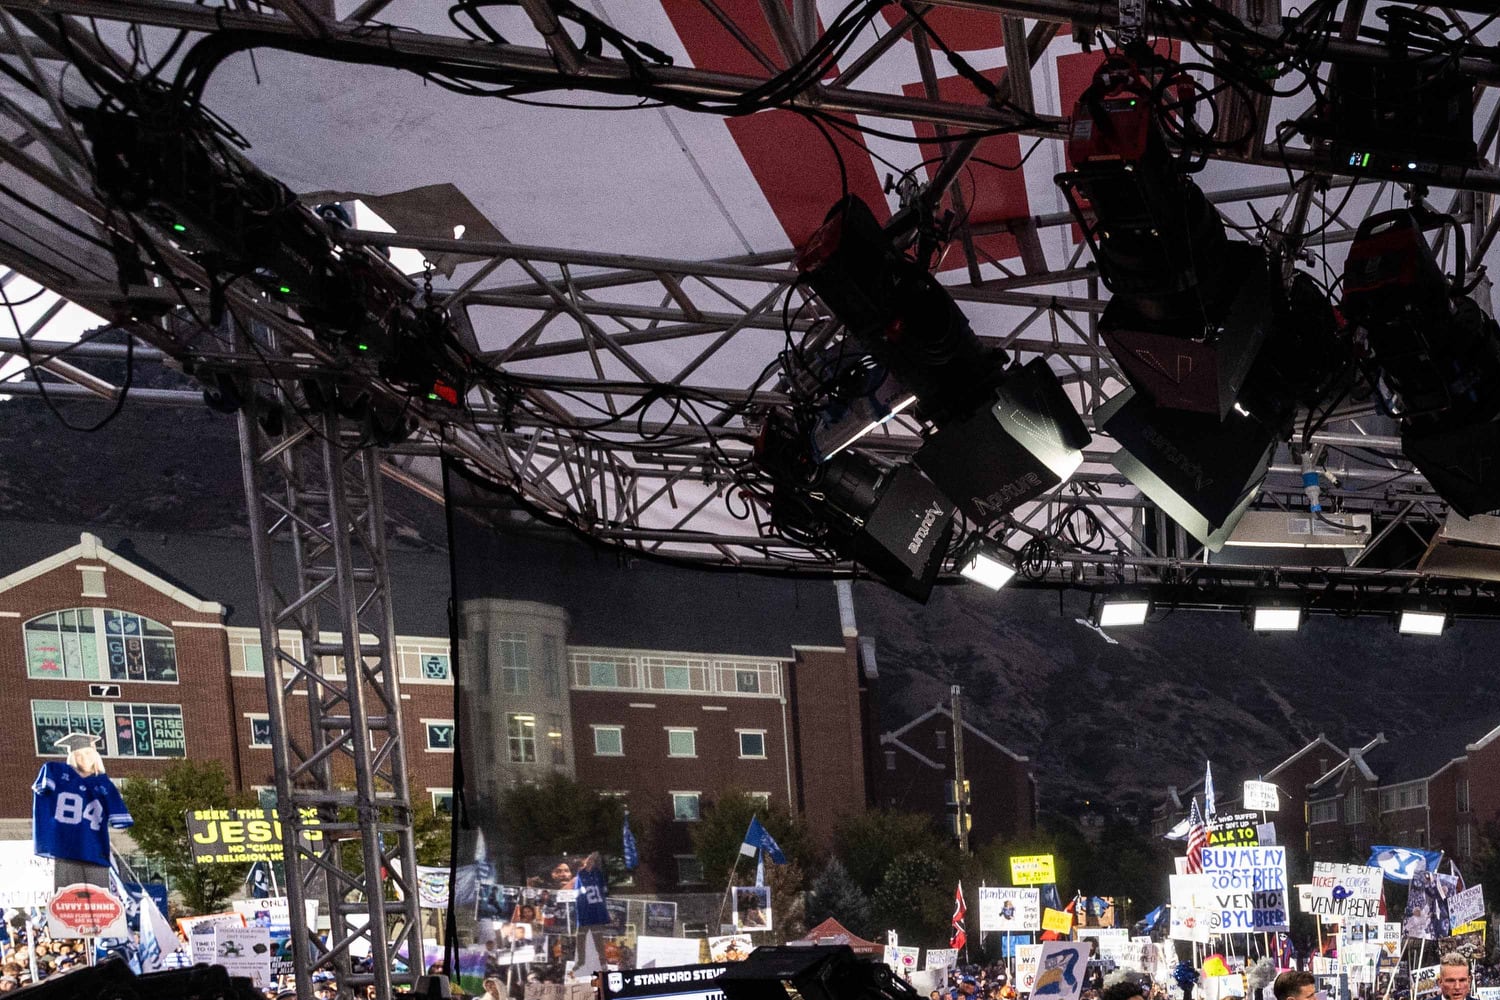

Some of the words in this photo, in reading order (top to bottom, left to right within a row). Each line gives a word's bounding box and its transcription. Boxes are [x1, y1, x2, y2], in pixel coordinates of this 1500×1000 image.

[970, 471, 1043, 517] Aputure
[907, 500, 945, 555] Aputure
[99, 685, 110, 697] 7
[153, 718, 183, 728] RISE
[155, 729, 184, 738] AND
[54, 791, 104, 830] 84
[194, 810, 230, 820] SEEK
[238, 810, 264, 820] THE
[1209, 829, 1235, 844] ALK
[1237, 827, 1255, 839] TO
[229, 845, 245, 853] NO
[196, 855, 214, 864] NO
[216, 853, 270, 863] RELIGION,
[1202, 849, 1237, 868] BUY
[1239, 849, 1262, 867] ME
[1263, 849, 1284, 866] MY
[1314, 863, 1336, 874] HELP
[1252, 867, 1286, 892] BEER
[1311, 876, 1337, 888] TICKET
[1215, 892, 1283, 909] VENMO:
[634, 970, 692, 986] STANFORD
